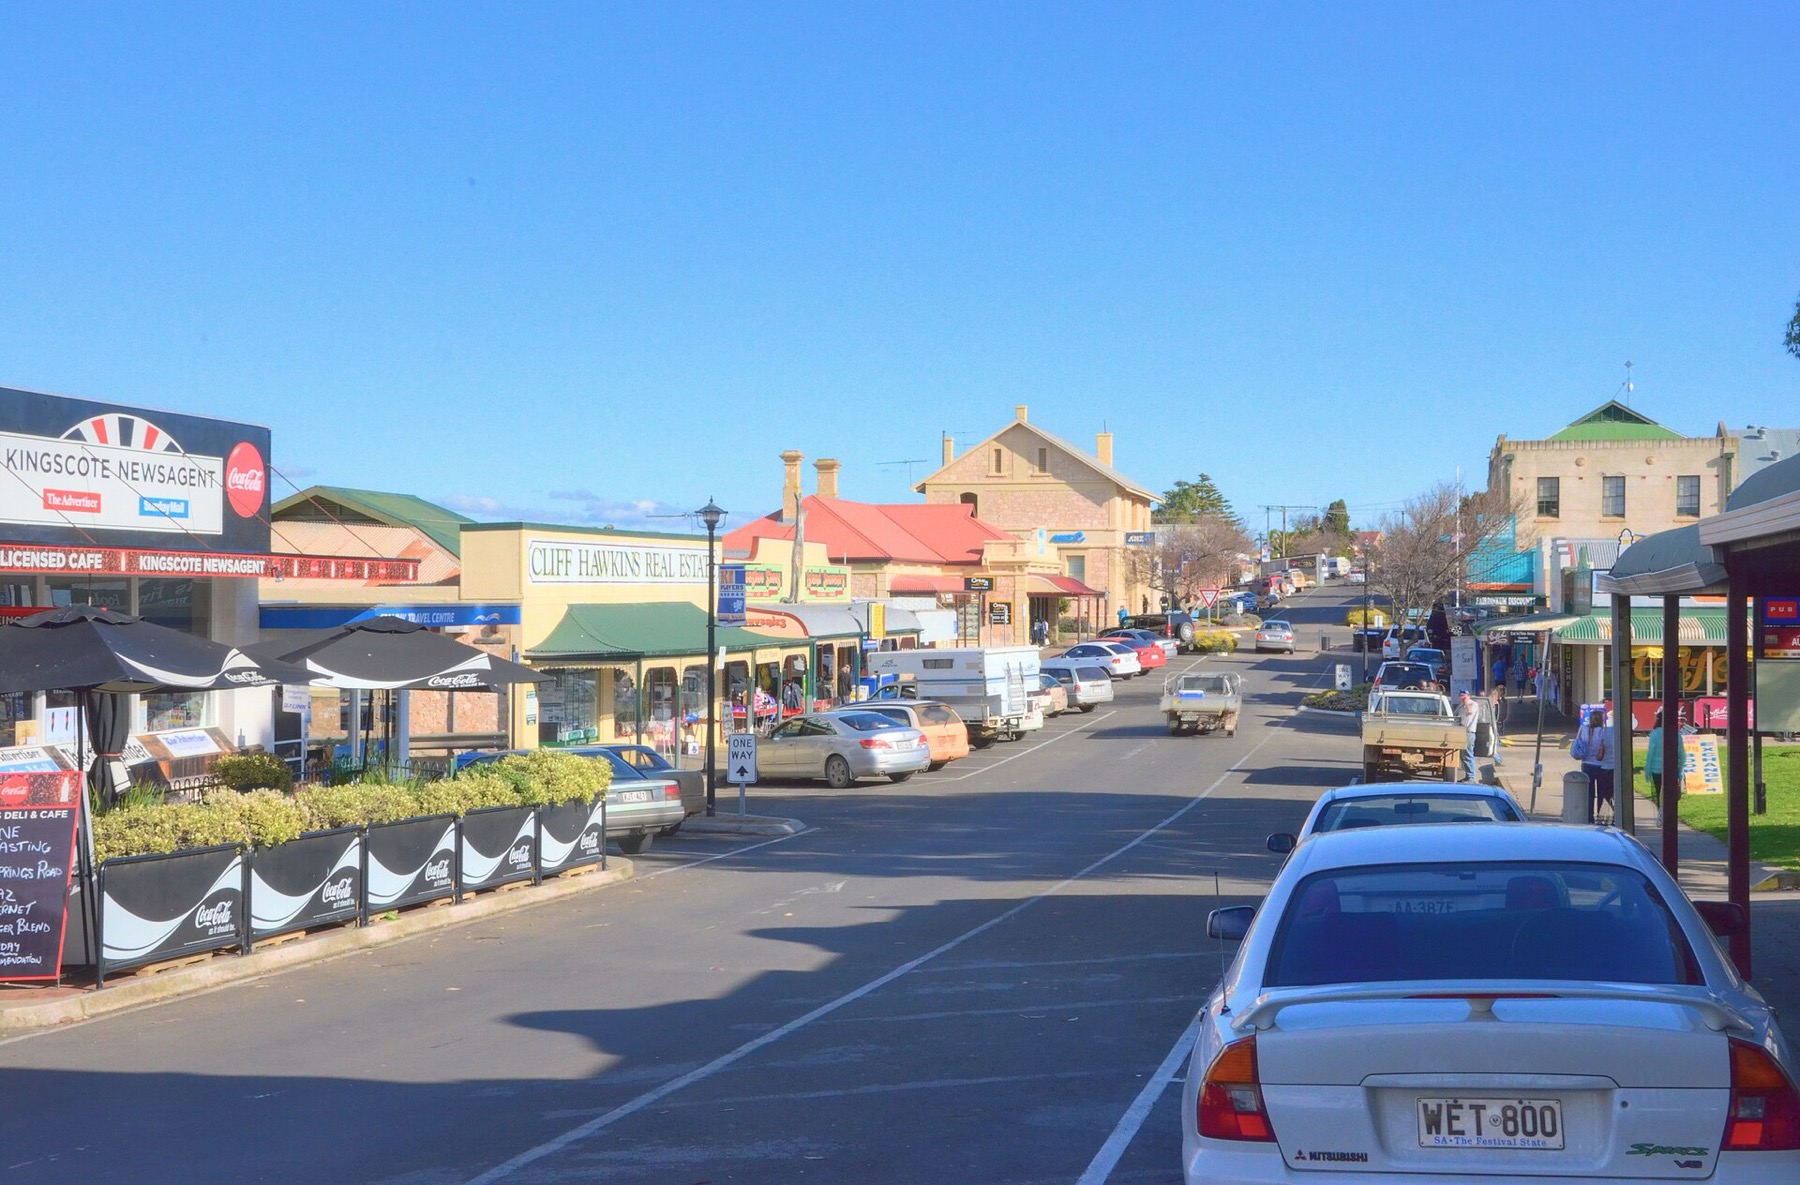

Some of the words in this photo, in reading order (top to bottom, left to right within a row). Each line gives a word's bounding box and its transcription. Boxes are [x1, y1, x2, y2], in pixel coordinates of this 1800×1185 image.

[6, 448, 110, 479] KINGSCOTE
[118, 460, 216, 489] NEWSAGENT
[228, 466, 263, 491] Coca-Cola
[47, 492, 61, 506] The
[62, 494, 99, 509] Advertiser
[0, 550, 66, 568] LICENSED
[68, 552, 103, 569] CAFE
[139, 555, 201, 572] KINGSCOTE
[203, 560, 266, 574] NEWSAGENT
[531, 546, 572, 576] CLIFF
[579, 548, 640, 577] HAWKINS
[645, 552, 675, 578] REAL
[408, 612, 431, 623] TRAVEL
[431, 612, 455, 623] CENTRE
[428, 672, 480, 687] Coca-Cola
[732, 738, 752, 748] ONE
[731, 750, 754, 760] WAY
[4, 811, 28, 820] DELI
[30, 811, 38, 819] &
[40, 810, 68, 819] CAFE
[580, 831, 599, 850] Coca-Cola
[508, 844, 530, 865] Coca-Cola
[425, 859, 450, 881] Coca-Cola
[322, 877, 353, 903] Coca-Cola
[195, 900, 233, 928] Coca-Cola
[16, 918, 51, 936] BLEND
[1422, 1102, 1487, 1137] WET
[1501, 1104, 1557, 1138] 800
[1476, 1137, 1517, 1146] Festival
[1520, 1138, 1547, 1147] State
[1309, 1151, 1368, 1163] MITSUBISHI
